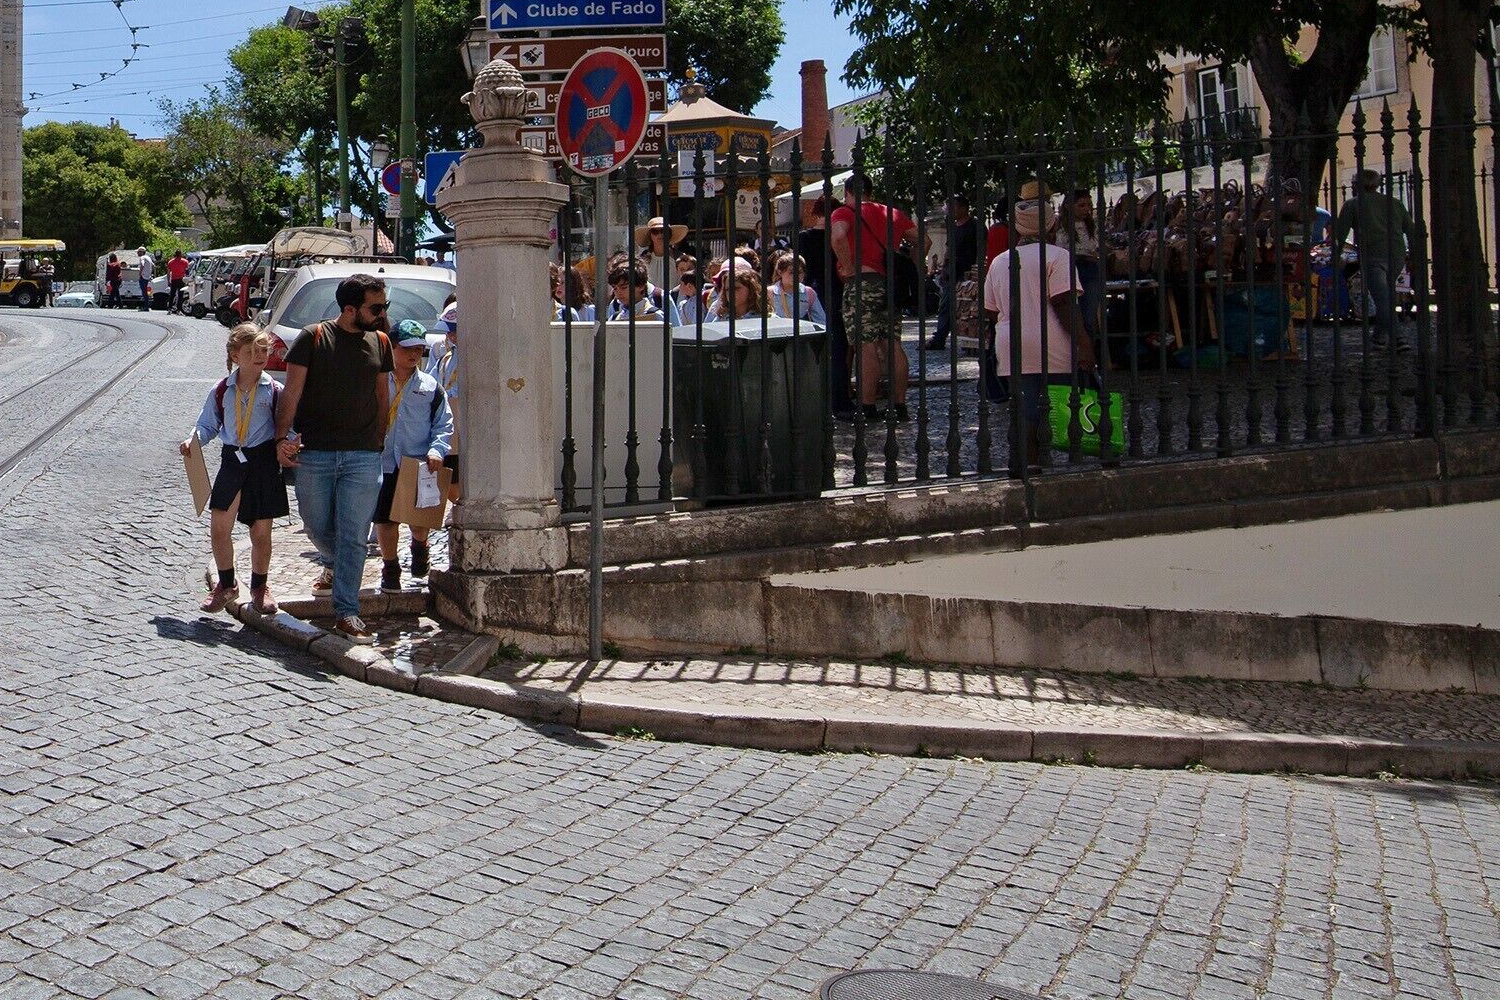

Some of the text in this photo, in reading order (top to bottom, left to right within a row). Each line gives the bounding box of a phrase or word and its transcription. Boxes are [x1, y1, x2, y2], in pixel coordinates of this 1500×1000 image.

[526, 0, 656, 18] Clube de Fado
